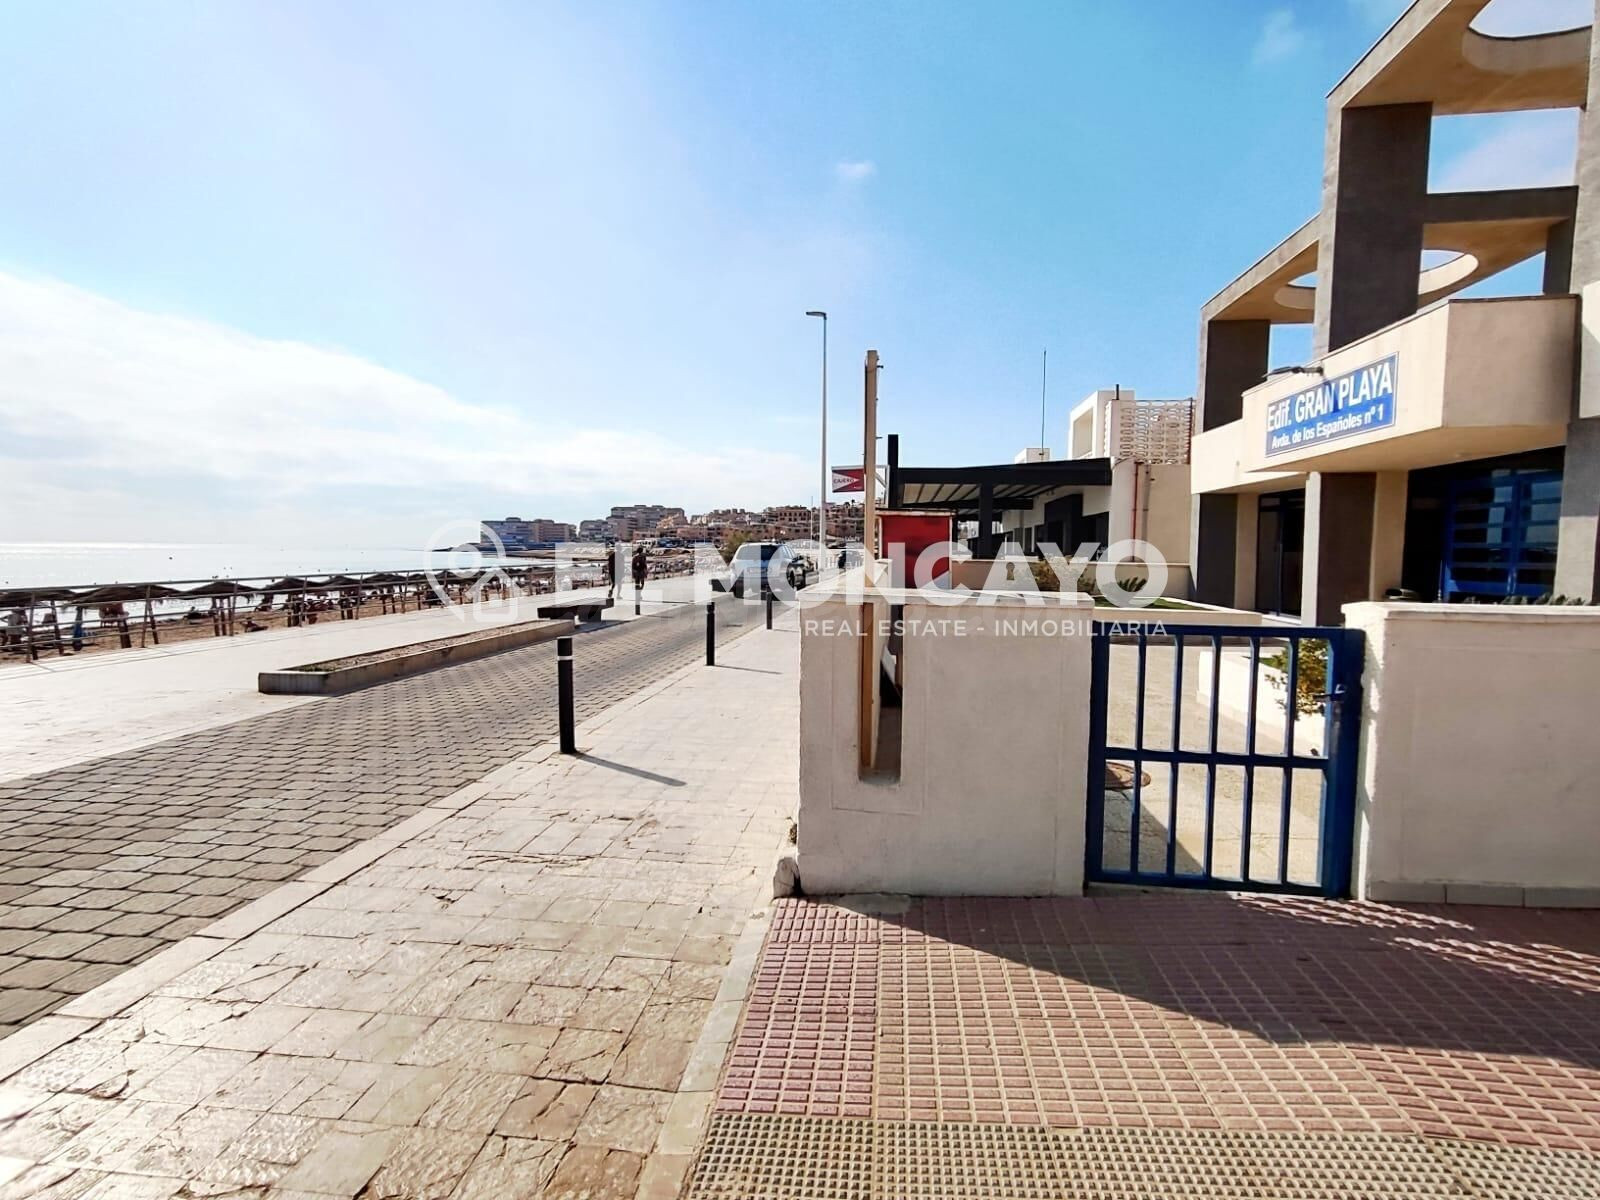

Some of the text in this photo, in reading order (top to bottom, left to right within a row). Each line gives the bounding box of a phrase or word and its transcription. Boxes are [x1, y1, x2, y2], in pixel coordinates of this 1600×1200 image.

[1267, 362, 1393, 432] Edif. GRAN PLAYA
[1272, 435, 1291, 449] Avda.
[1292, 430, 1302, 443] de
[1303, 427, 1315, 440] los
[1316, 413, 1362, 438] Españoles
[1378, 403, 1384, 420] 1
